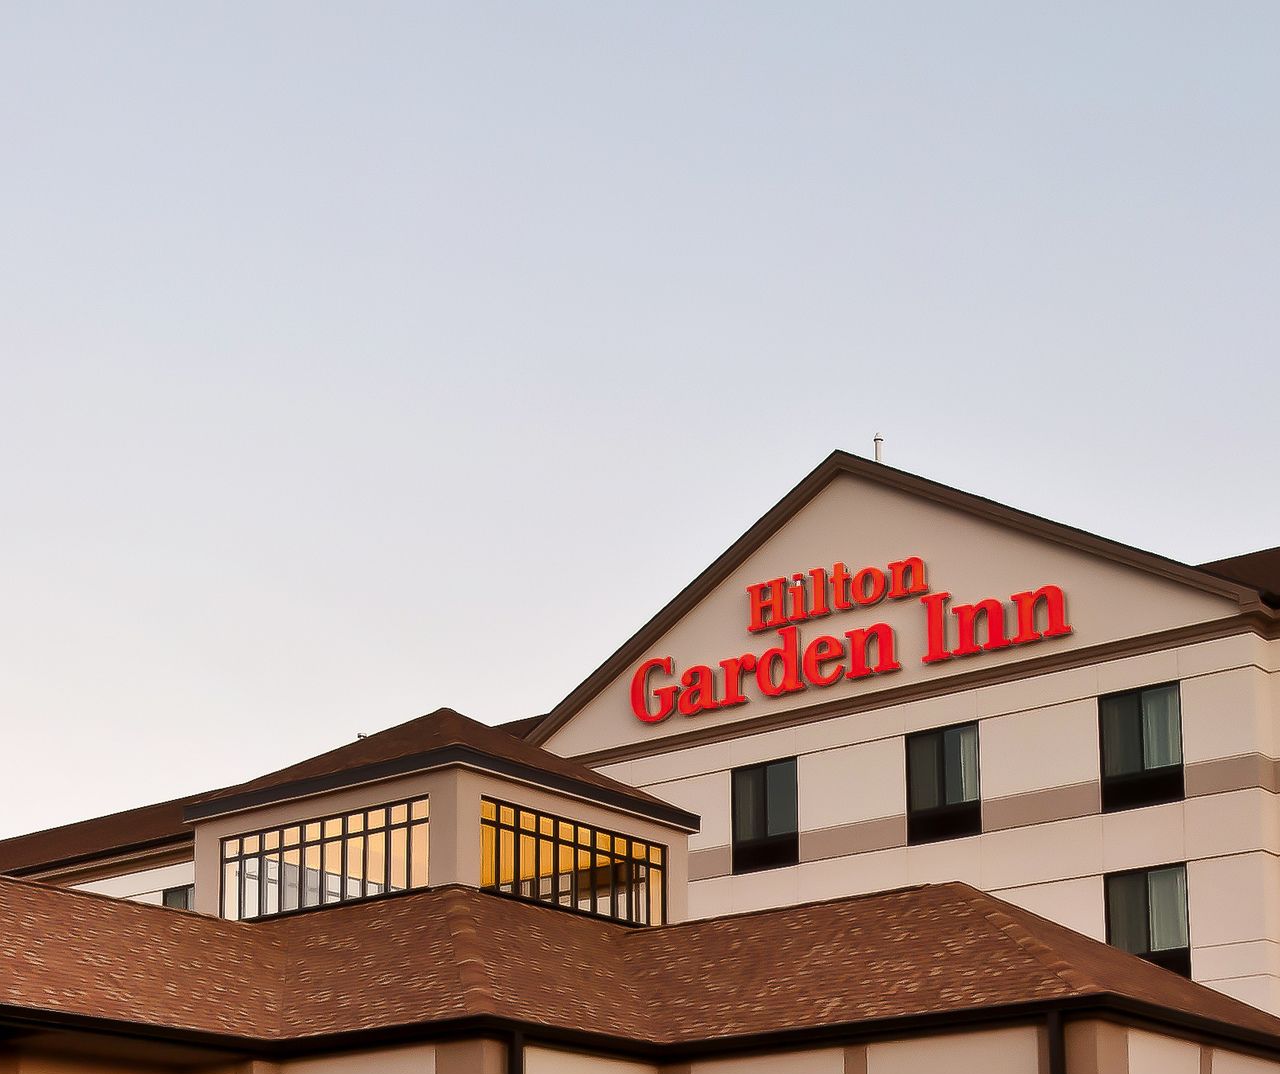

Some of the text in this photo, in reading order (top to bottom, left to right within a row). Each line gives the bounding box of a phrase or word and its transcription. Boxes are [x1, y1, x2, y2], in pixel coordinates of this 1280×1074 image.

[746, 556, 928, 632] Hilton
[630, 584, 1073, 723] Garden Inn
